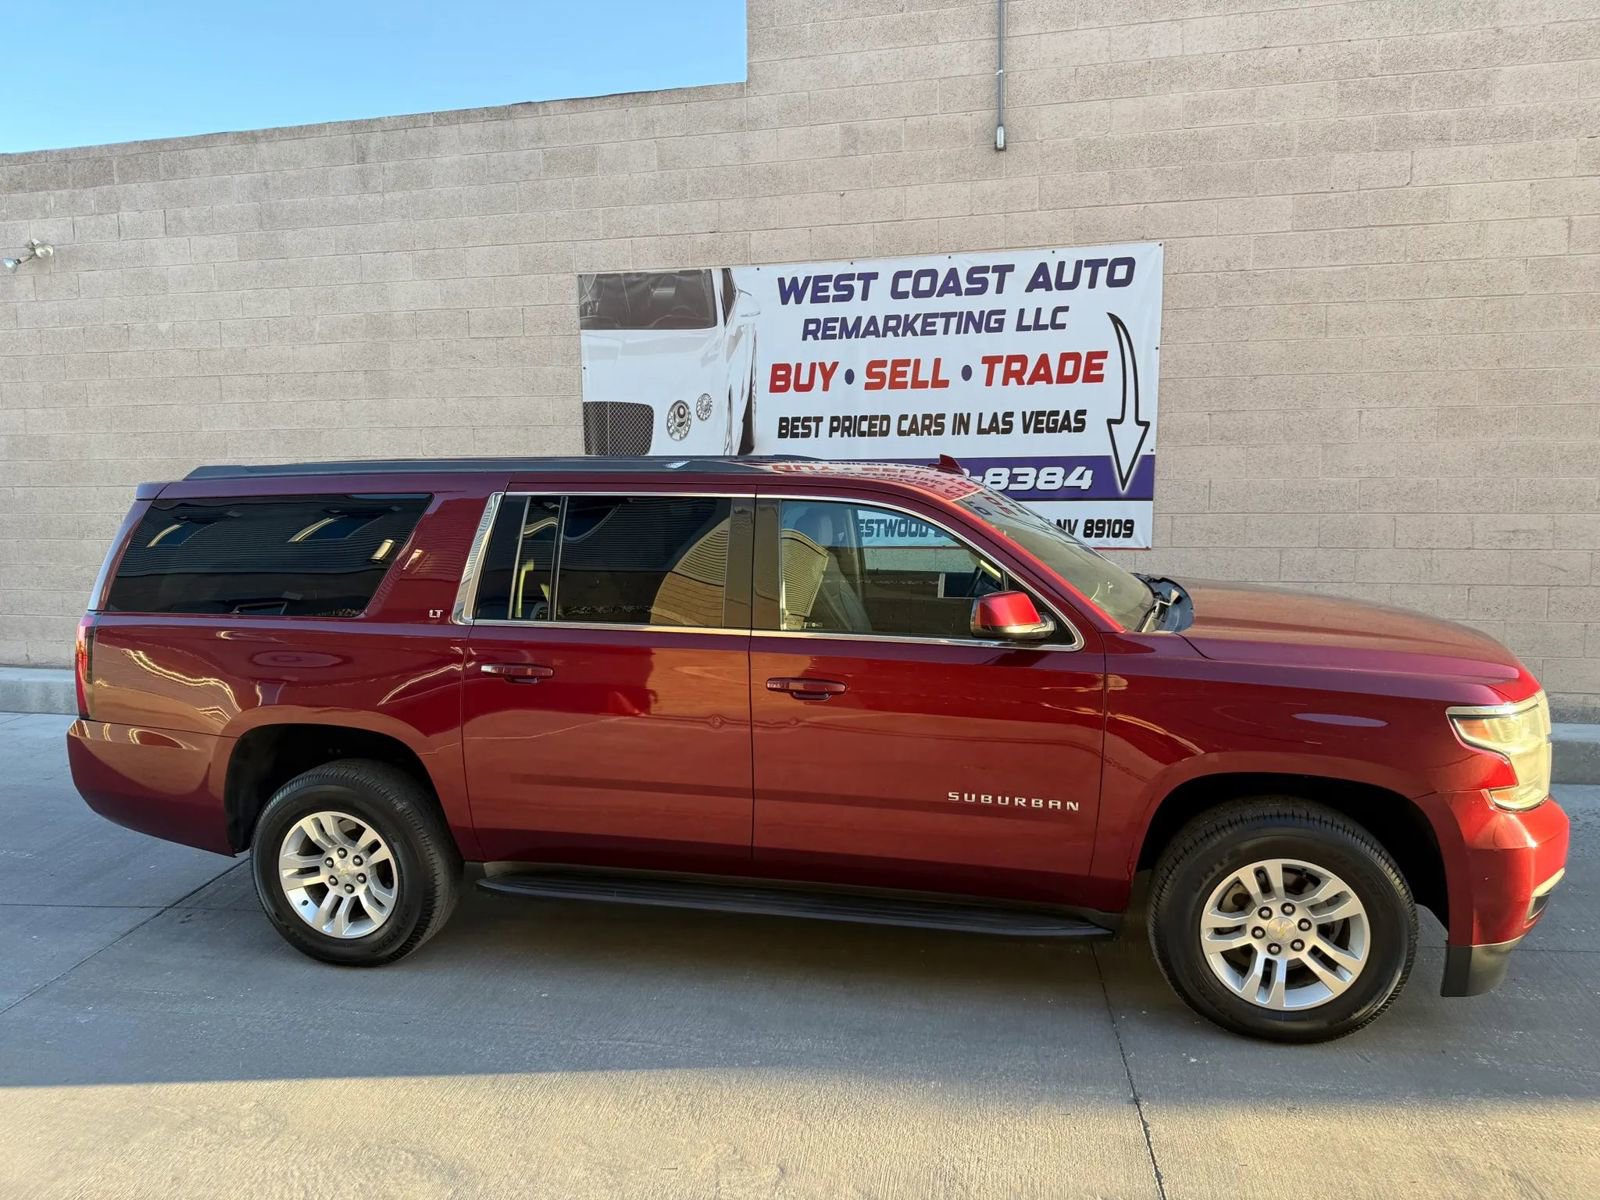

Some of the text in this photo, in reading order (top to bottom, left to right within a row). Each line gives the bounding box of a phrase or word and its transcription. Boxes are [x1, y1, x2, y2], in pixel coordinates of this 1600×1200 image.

[777, 256, 1136, 305] WEST COAST AUTO
[801, 305, 1070, 341] REMARKETING LLC
[768, 350, 1109, 393] BUY SELL TRADE
[777, 409, 1087, 439] BEST PRICED CARS IN LAS VEGAS
[961, 466, 1093, 491] -8384
[1083, 518, 1135, 539] 89109
[429, 609, 444, 618] LT
[947, 791, 1079, 811] SUBURBAN
